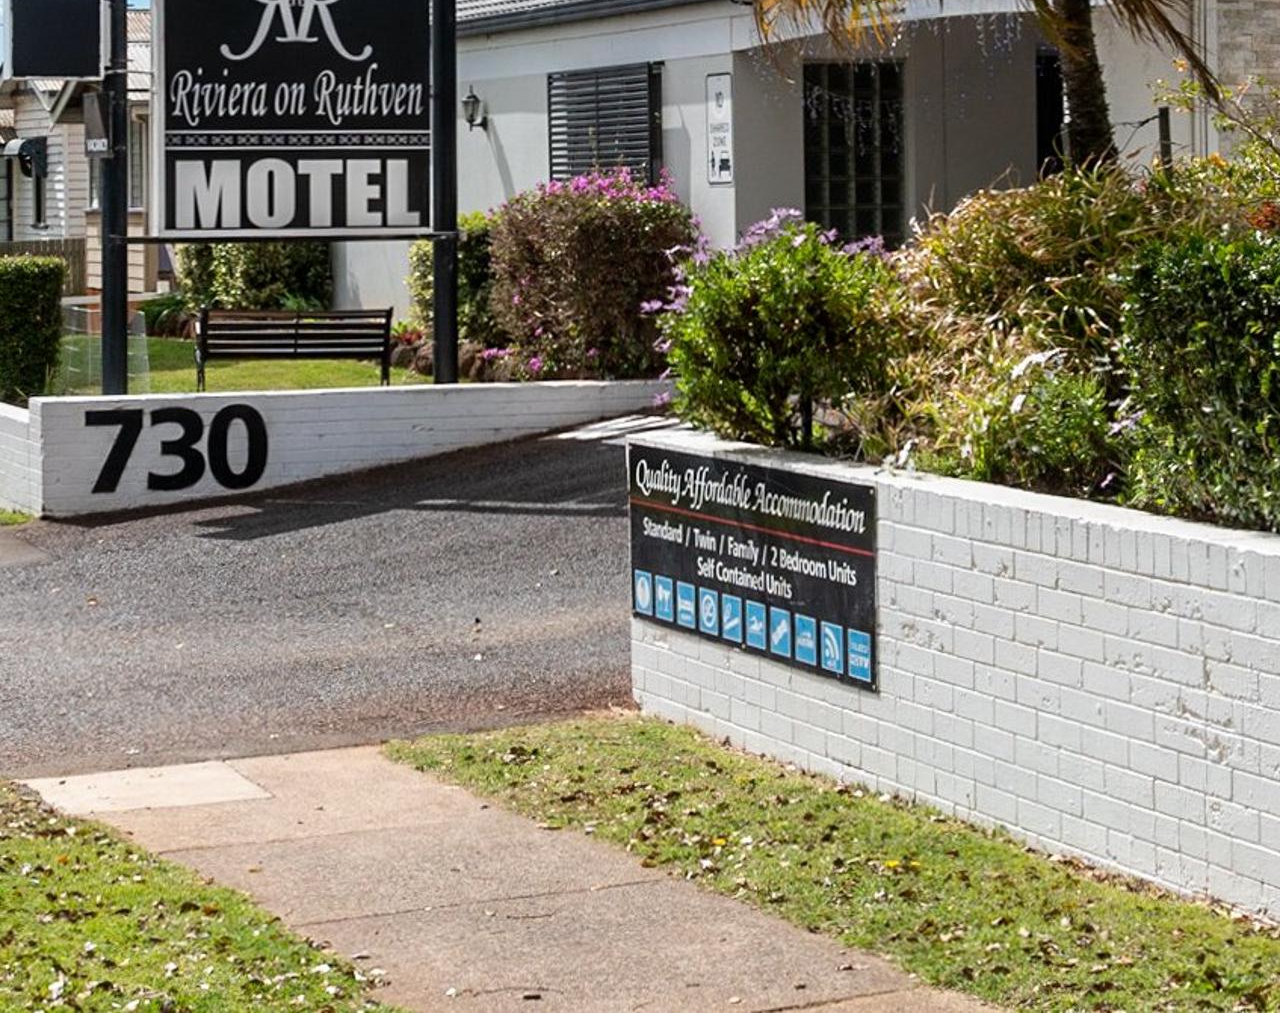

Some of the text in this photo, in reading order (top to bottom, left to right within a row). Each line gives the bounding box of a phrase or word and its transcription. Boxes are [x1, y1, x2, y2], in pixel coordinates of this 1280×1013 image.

[171, 62, 424, 126] Riviera on Ruthven
[175, 158, 420, 229] MOTEL
[84, 404, 269, 494] 730
[636, 459, 866, 534] Quality Affordable Accommodation
[643, 516, 857, 586] Standard / Twin / Family / 2 Bedroom Units
[697, 556, 793, 598] Self Contained Units
